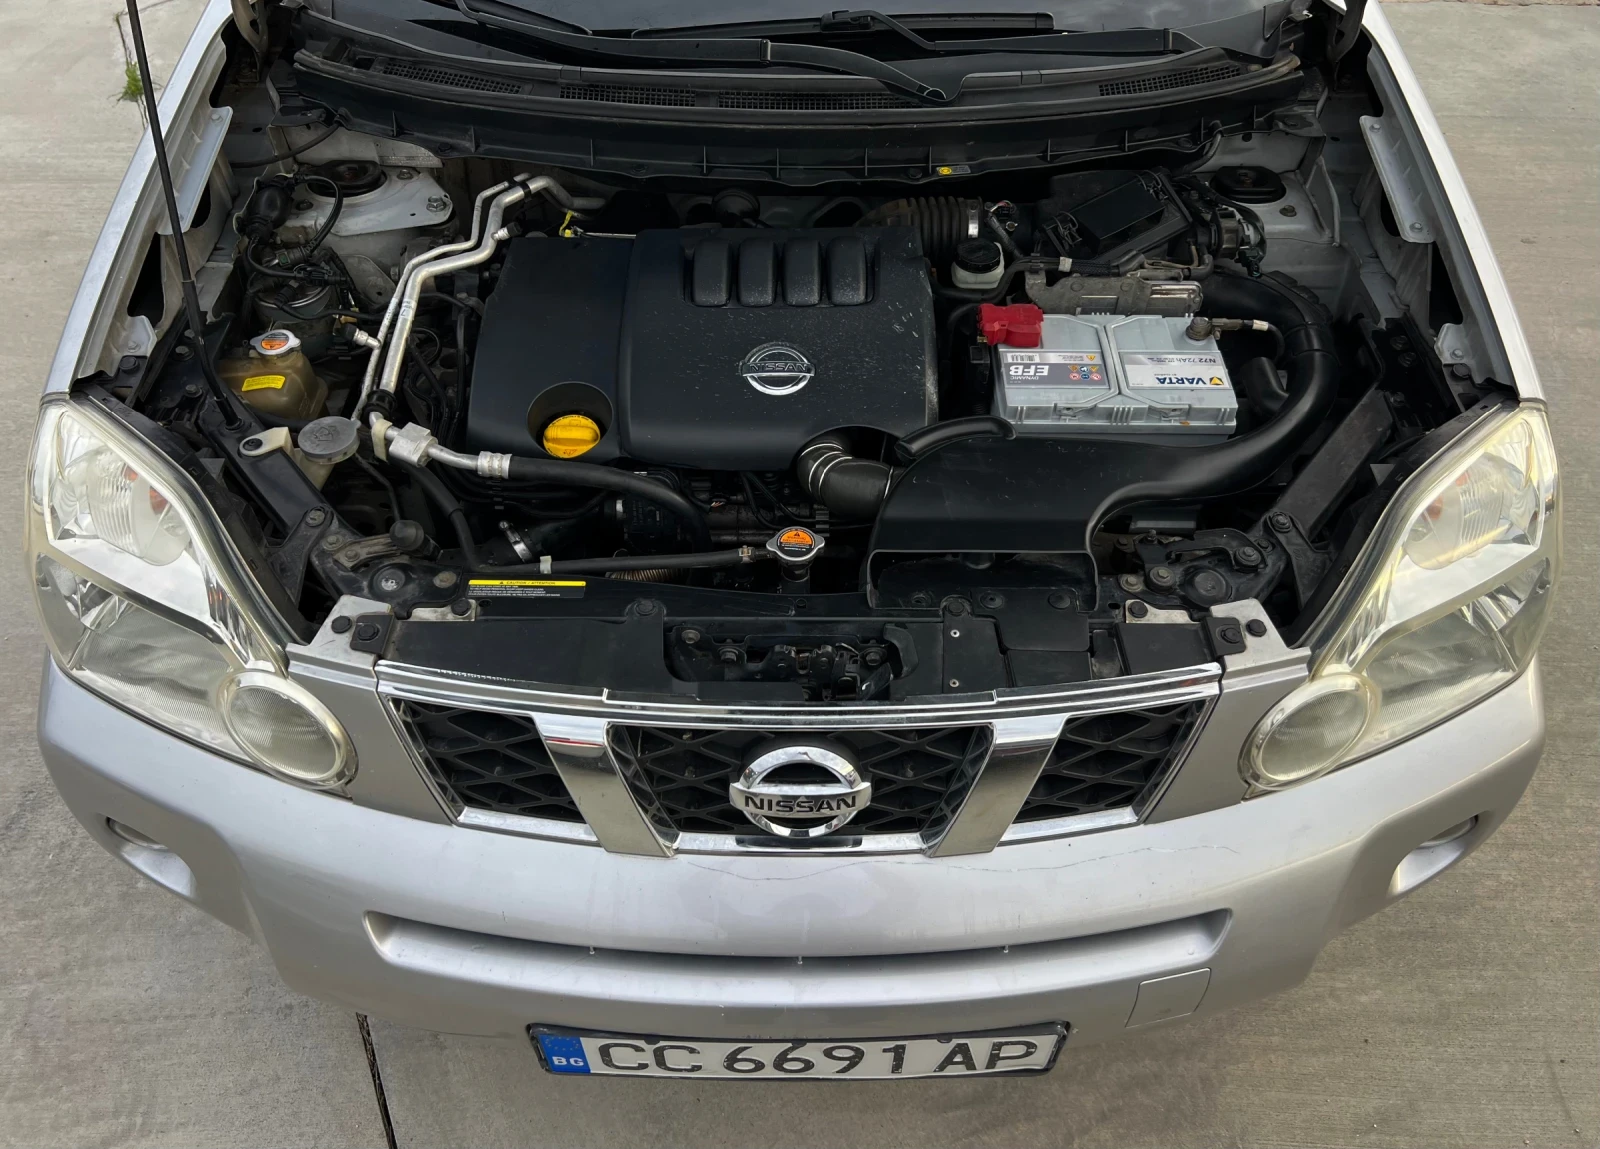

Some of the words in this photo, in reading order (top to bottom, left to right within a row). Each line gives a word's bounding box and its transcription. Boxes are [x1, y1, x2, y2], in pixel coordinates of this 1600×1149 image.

[750, 363, 807, 371] NISSAN
[1009, 365, 1049, 376] EFB
[1156, 376, 1207, 385] VARTA
[744, 795, 856, 813] NISSAN
[552, 1056, 584, 1066] BG
[598, 1042, 703, 1073] CC
[723, 1043, 906, 1074] 6691
[933, 1040, 1038, 1073] AP
